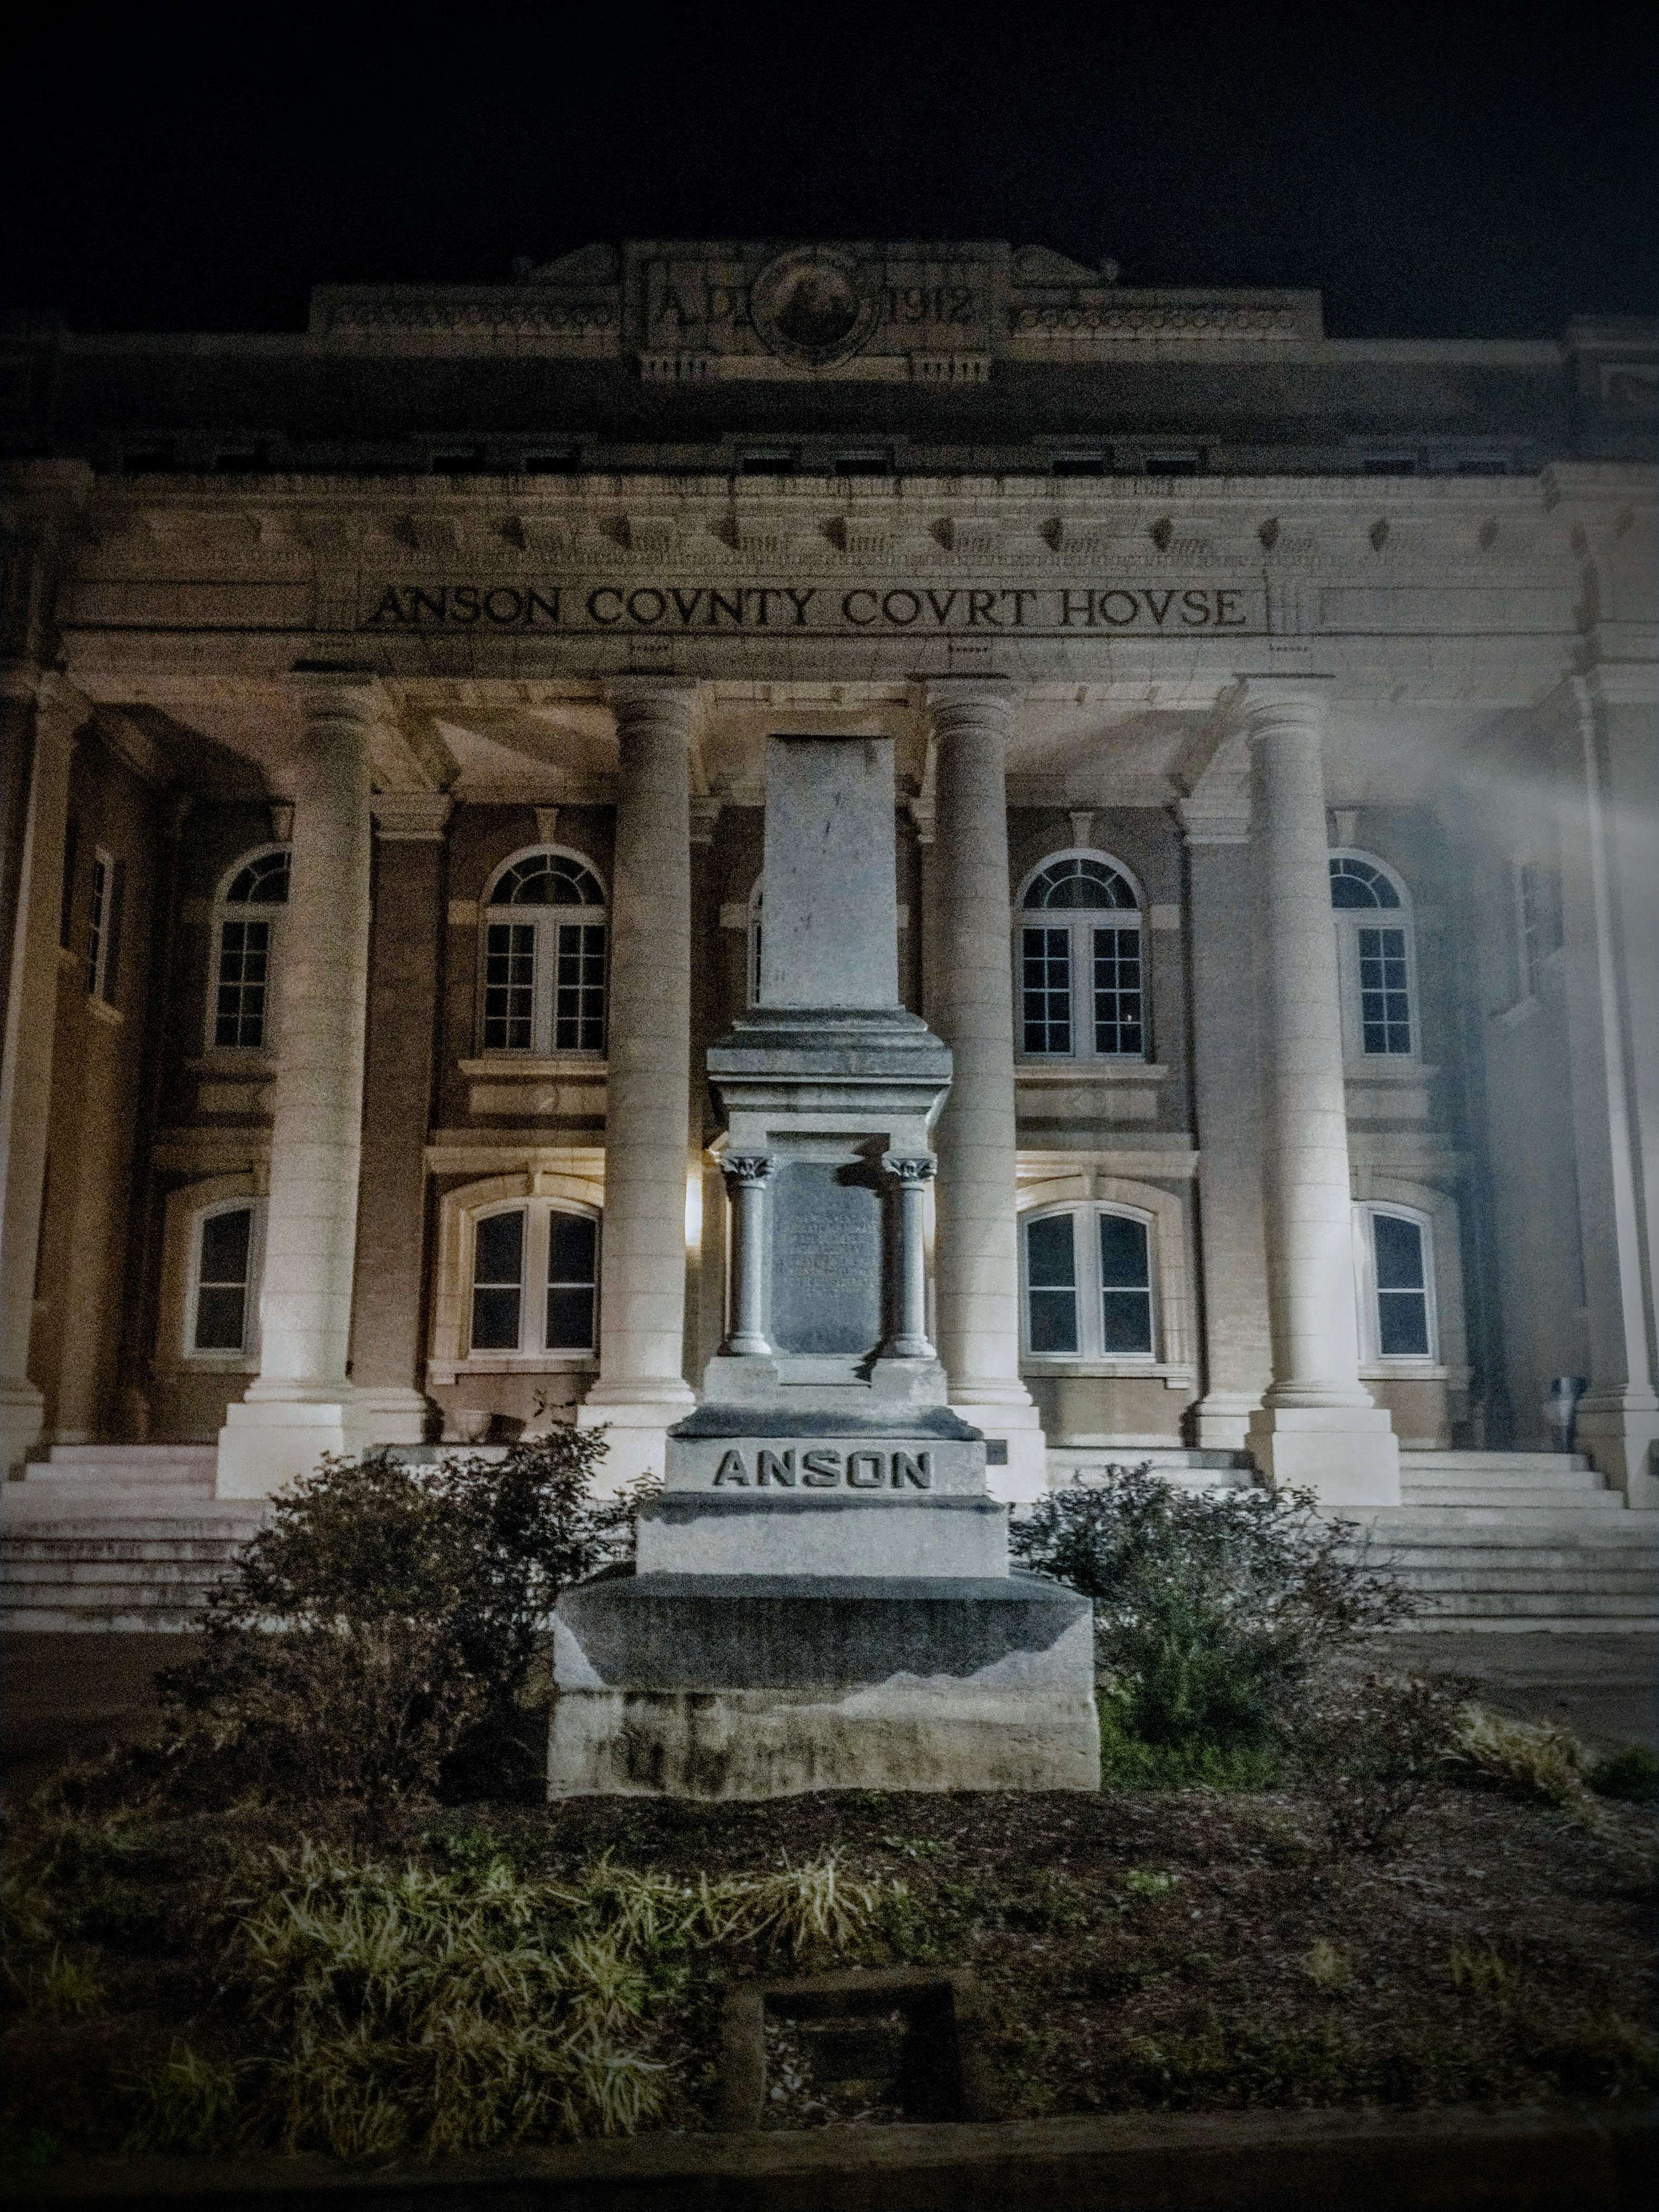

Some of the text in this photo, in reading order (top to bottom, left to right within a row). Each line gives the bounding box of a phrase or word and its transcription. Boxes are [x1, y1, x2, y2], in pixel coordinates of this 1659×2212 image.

[883, 285, 972, 326] 1912
[367, 586, 1247, 627] ANSON COVNTY COVRT HOVSE
[712, 1447, 932, 1490] ANSON
